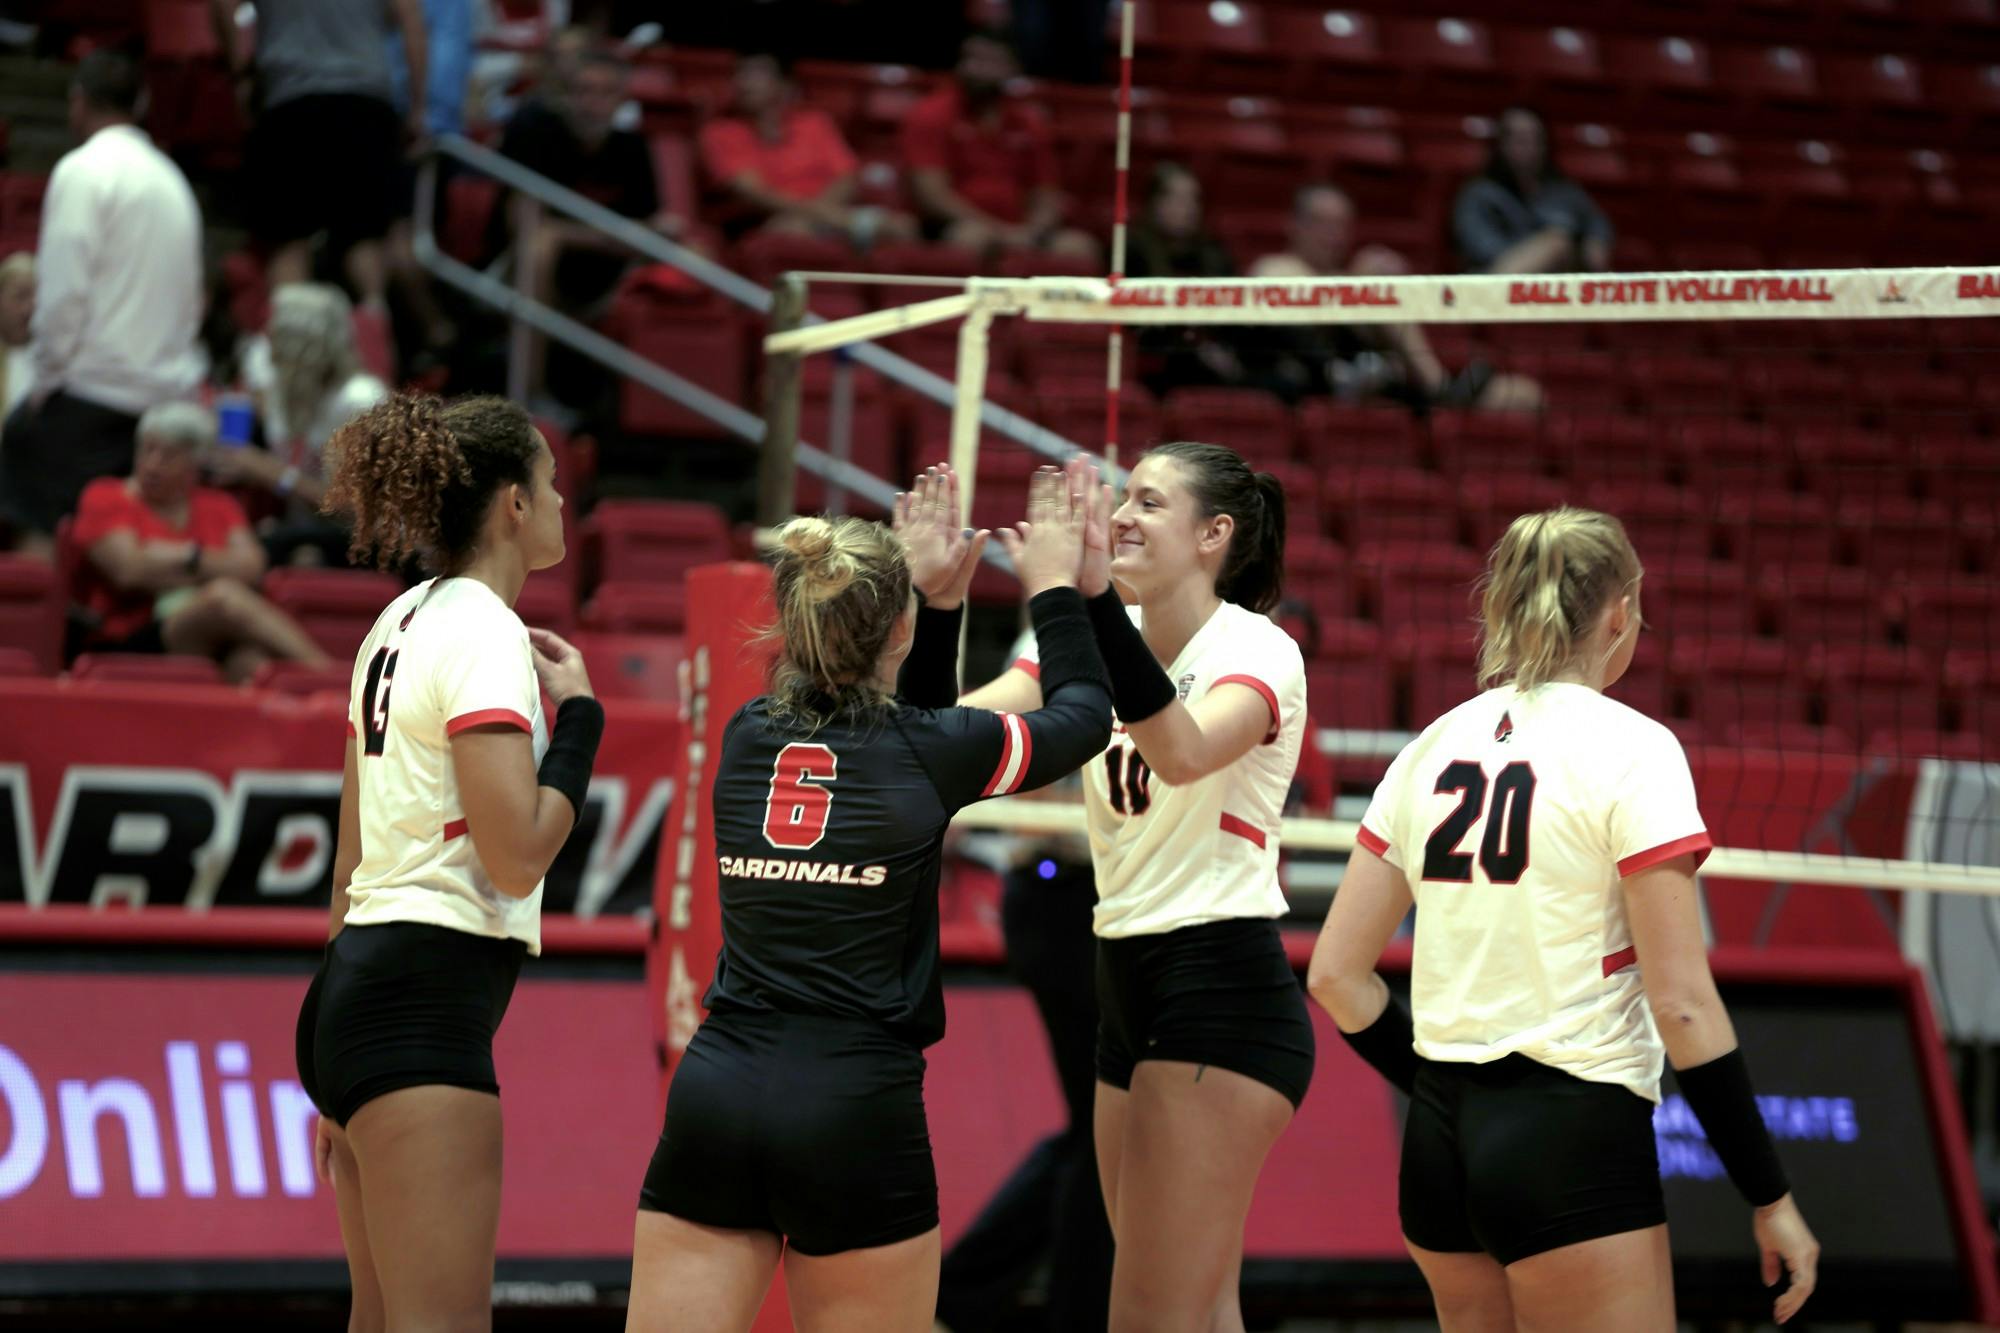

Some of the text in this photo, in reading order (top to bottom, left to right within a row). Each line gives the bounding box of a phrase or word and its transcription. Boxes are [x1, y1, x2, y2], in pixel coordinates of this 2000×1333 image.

[1110, 286, 1166, 306] BALL
[1175, 286, 1244, 306] STATE
[1252, 284, 1399, 306] VOLLEYBALL
[1508, 277, 1834, 304] BALL STATE VOLLEYBALL
[1956, 273, 2000, 299] BA
[762, 741, 838, 850] 6
[1105, 744, 1151, 816] 10
[1421, 759, 1537, 885] 20
[718, 856, 888, 887] CARDINALS
[1754, 1094, 1859, 1142] TATE
